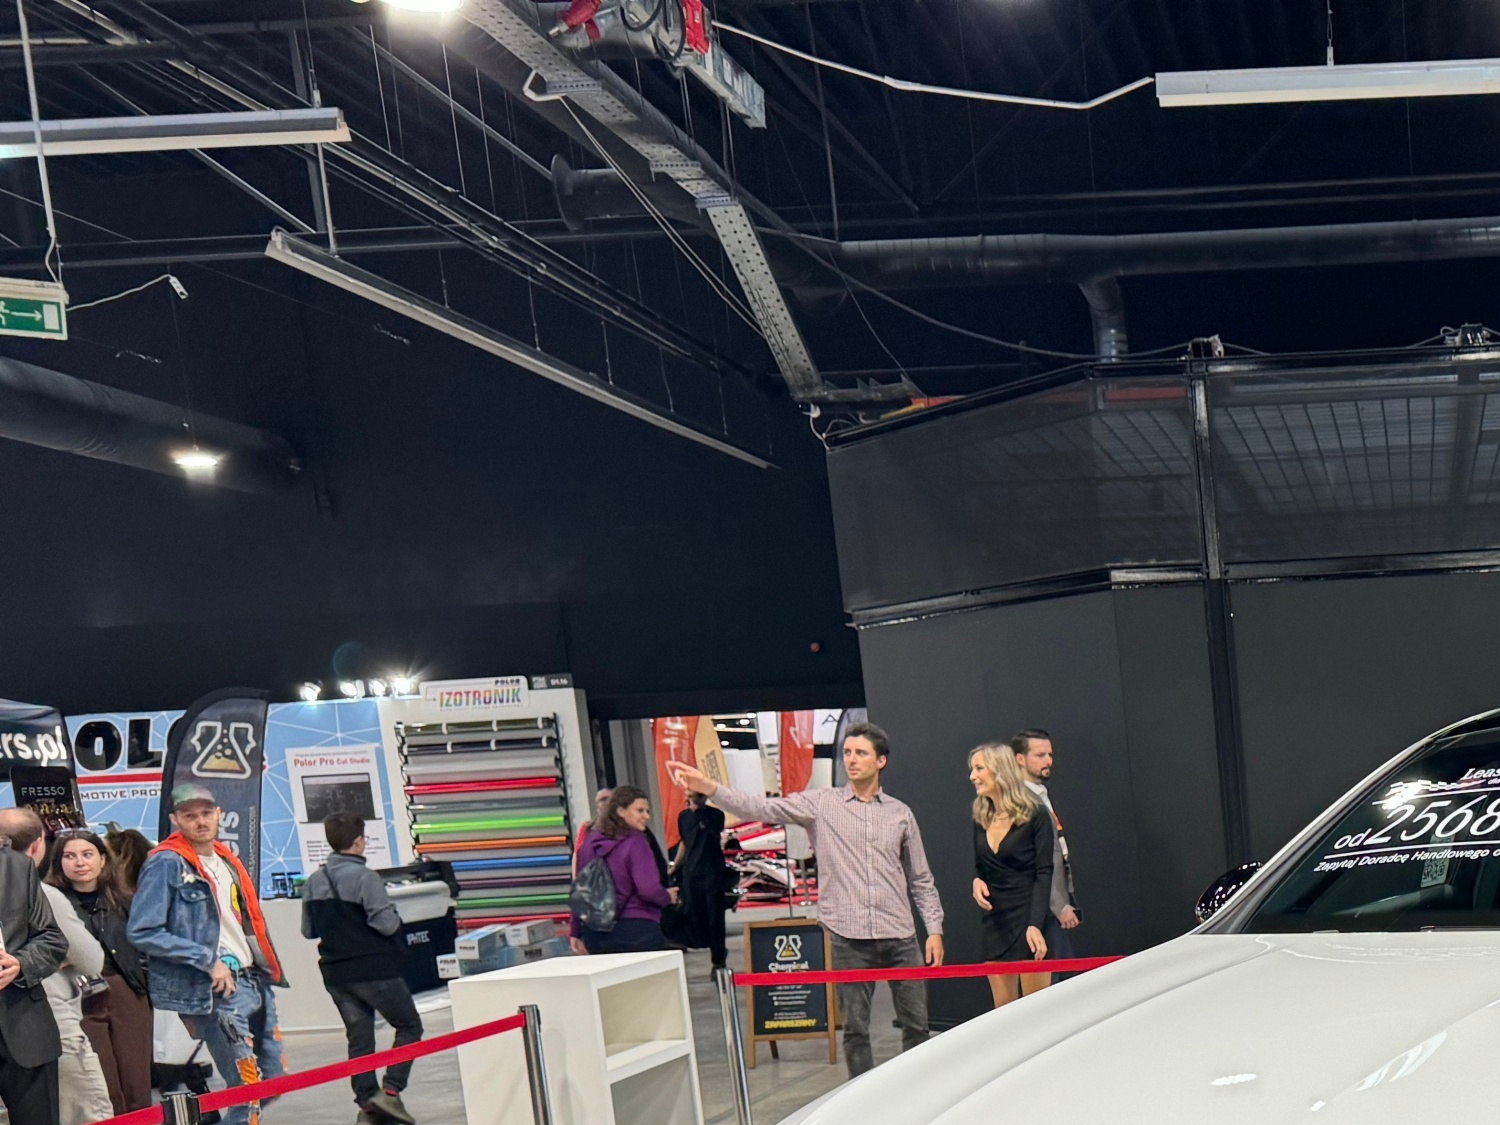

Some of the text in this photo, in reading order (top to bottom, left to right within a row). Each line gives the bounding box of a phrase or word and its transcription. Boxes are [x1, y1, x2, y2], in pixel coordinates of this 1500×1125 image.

[439, 688, 521, 708] IZOTRONIK
[0, 725, 67, 767] rs.pl
[73, 717, 180, 772] OL
[319, 757, 334, 766] Pro
[21, 786, 65, 797] FRESSO
[1334, 829, 1372, 850] od
[1313, 857, 1359, 872] Zapytaj
[1358, 853, 1409, 866] Doradcę
[1411, 848, 1489, 861] Handlowego
